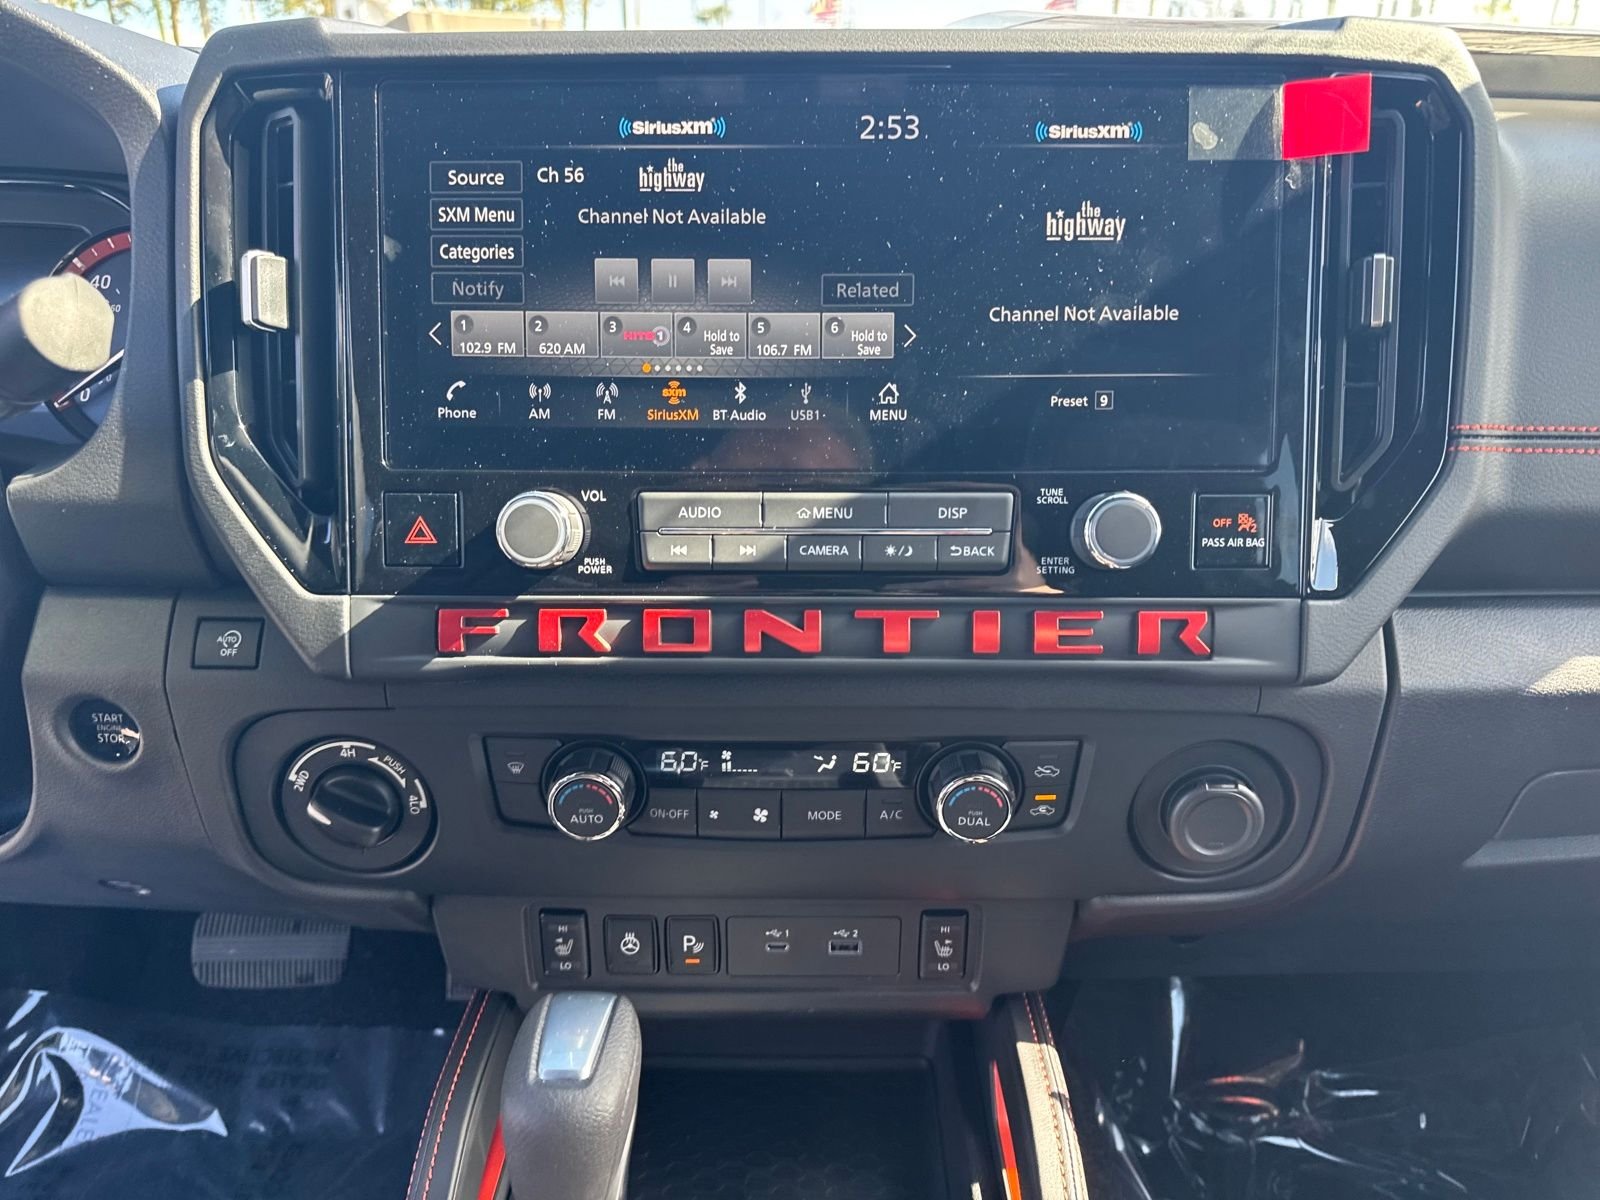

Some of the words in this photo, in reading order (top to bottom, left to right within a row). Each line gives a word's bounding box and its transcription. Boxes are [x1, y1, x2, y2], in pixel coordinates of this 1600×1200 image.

[860, 115, 920, 140] 2:53
[667, 157, 685, 172] the
[447, 169, 505, 186] Source
[537, 167, 559, 183] Ch
[564, 167, 584, 183] 56
[639, 166, 705, 192] highway
[438, 207, 470, 223] SXM
[474, 206, 515, 223] Menu
[1081, 200, 1100, 217] the
[577, 207, 648, 224] Channel
[652, 208, 684, 224] Not
[687, 207, 766, 224] Available
[1046, 210, 1126, 241] highway
[439, 243, 515, 263] Categories
[90, 274, 111, 290] 40
[452, 280, 504, 300] Notify
[837, 281, 899, 298] Related
[989, 305, 1059, 322] Channel
[1063, 305, 1096, 322] Not
[1099, 303, 1179, 321] Available
[460, 320, 466, 332] 1
[534, 321, 543, 332] 2
[609, 321, 617, 333] 3
[682, 321, 692, 333] 4
[757, 321, 765, 333] 5
[831, 321, 839, 333] 6
[703, 329, 728, 342] Hold
[730, 331, 740, 342] to
[851, 329, 876, 342] Hold
[878, 331, 888, 342] to
[460, 342, 491, 354] 102.9
[497, 342, 516, 354] FM
[539, 343, 561, 355] 620
[564, 343, 585, 355] AM
[710, 343, 733, 355] Save
[756, 344, 787, 356] 106.7
[794, 344, 812, 356] FM
[857, 343, 881, 355] Save
[80, 389, 90, 402] 0
[1050, 395, 1088, 407] Preset
[1099, 395, 1108, 406] 9
[438, 407, 477, 419] Phone
[528, 408, 550, 420] AM
[597, 408, 616, 420] FM
[647, 408, 699, 421] SiriusXM
[712, 409, 727, 420] BT
[729, 409, 767, 421] Audio
[790, 409, 819, 421] USB1
[869, 409, 908, 421] MENU
[581, 490, 607, 502] VOL
[1040, 487, 1064, 496] TUNE
[1036, 496, 1069, 505] SCROLL
[678, 506, 722, 519] AUDIO
[812, 507, 853, 519] MENU
[938, 507, 968, 519] DISP
[1212, 518, 1233, 528] OFF
[1201, 537, 1225, 547] PASS
[1227, 537, 1244, 547] AIR
[1245, 537, 1265, 547] BAG
[799, 545, 849, 556] CAMERA
[963, 546, 995, 557] BACK
[584, 557, 606, 566] PUSH
[1041, 556, 1070, 566] ENTER
[578, 565, 613, 574] POWER
[1036, 566, 1075, 575] SETTING
[437, 608, 1212, 655] FRONTIER
[220, 648, 238, 657] OFF
[91, 712, 123, 723] START
[340, 748, 356, 758] 4H
[383, 755, 406, 775] PUSH
[293, 770, 310, 792] 2WD
[409, 794, 421, 815] 4LO
[570, 814, 603, 824] AUTO
[807, 810, 842, 821] MODE
[880, 810, 903, 820] A/C
[957, 816, 991, 827] DUAL
[558, 925, 568, 933] HI
[683, 935, 695, 953] P
[560, 962, 572, 970] LO
[938, 963, 949, 971] LO
